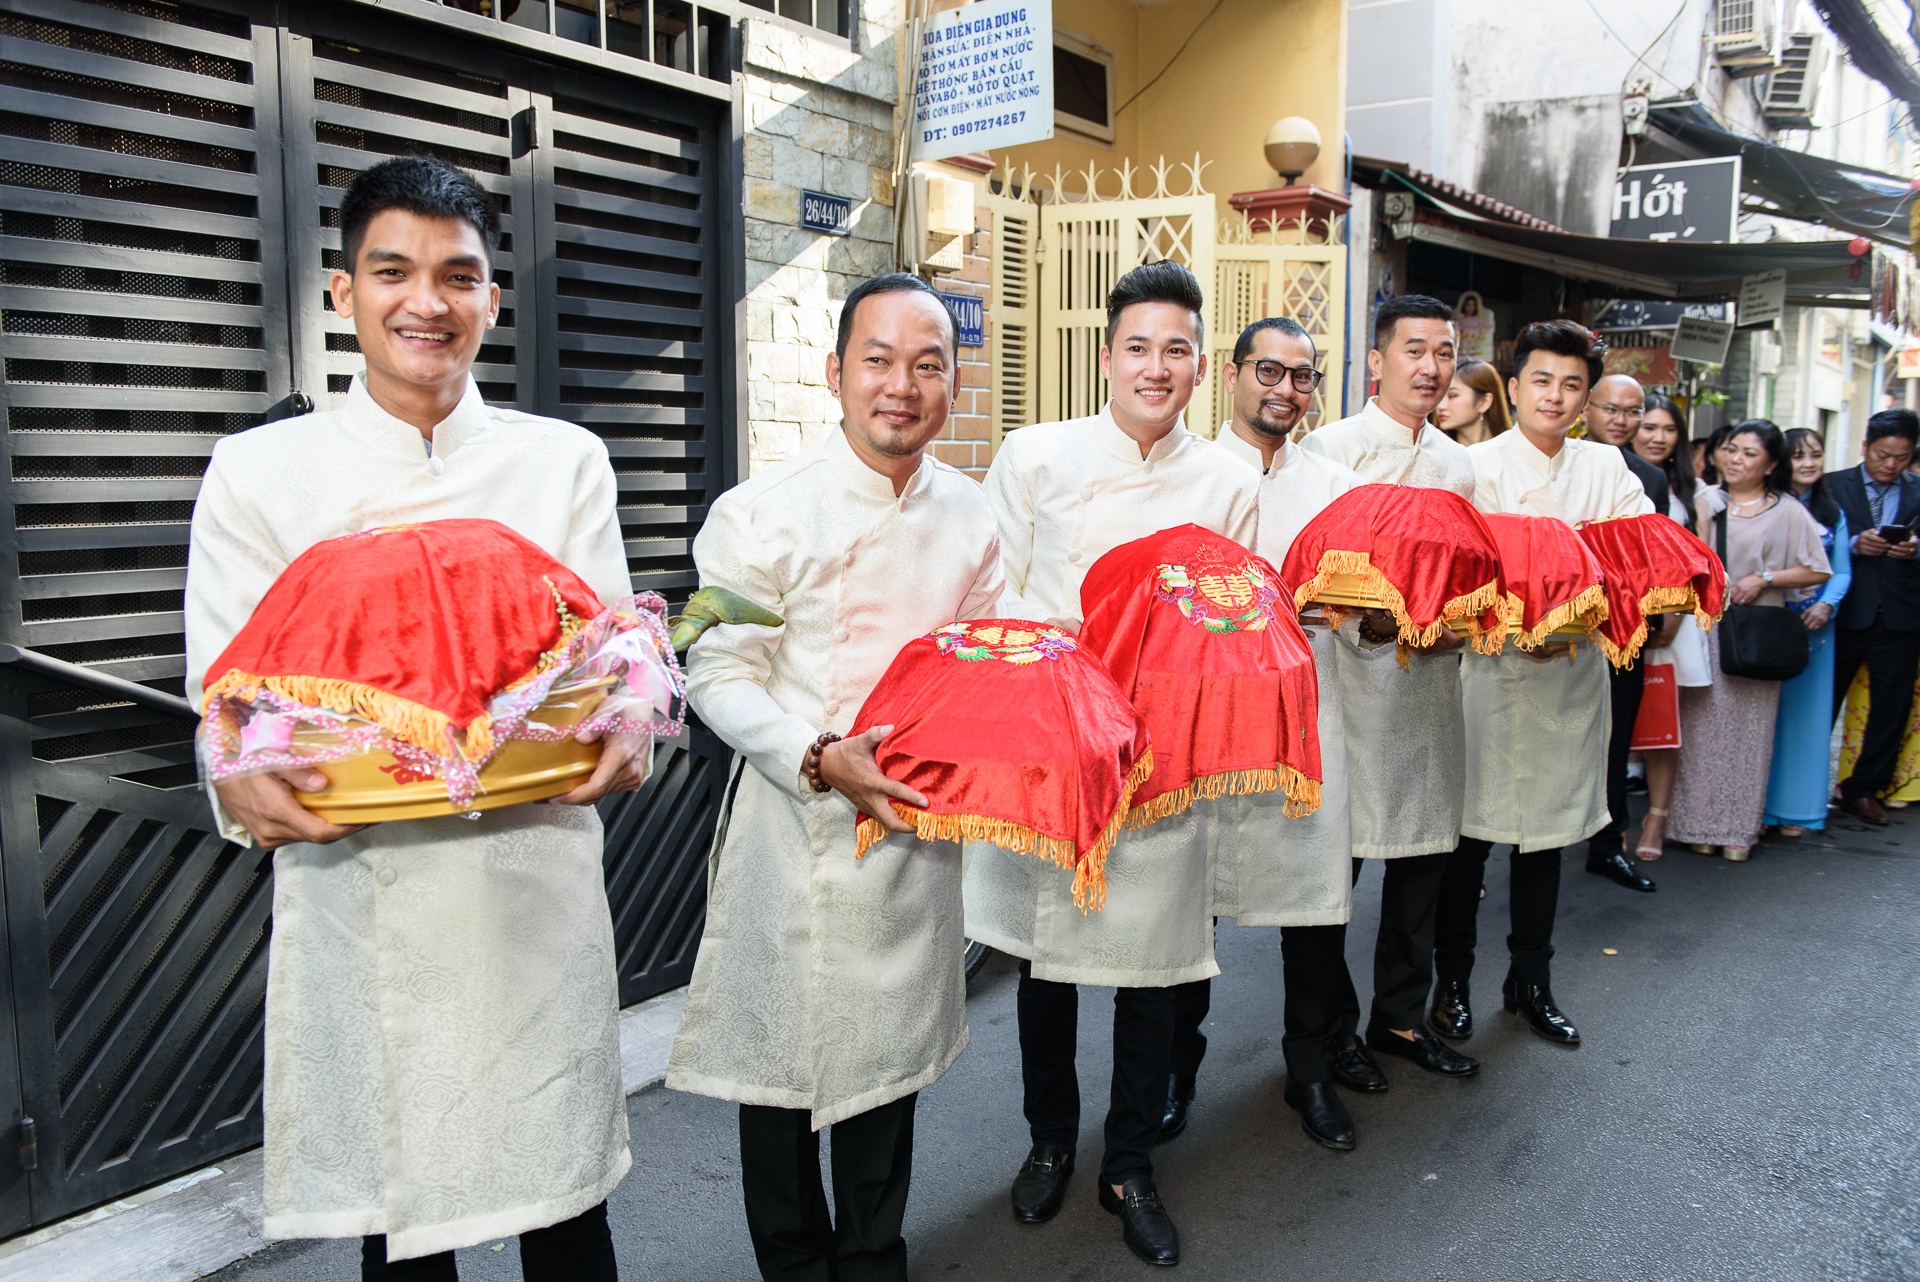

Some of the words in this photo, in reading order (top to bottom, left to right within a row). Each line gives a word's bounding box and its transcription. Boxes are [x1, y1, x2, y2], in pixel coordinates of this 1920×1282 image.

[974, 17, 993, 33] GIA
[995, 8, 1026, 29] DỤNG
[973, 49, 999, 65] BƠM
[1003, 70, 1035, 88] QUẠT
[923, 127, 947, 143] ĐT:
[952, 110, 1026, 137] 0907274267
[1611, 173, 1688, 221] Hớt
[805, 198, 848, 228] 26/44/10
